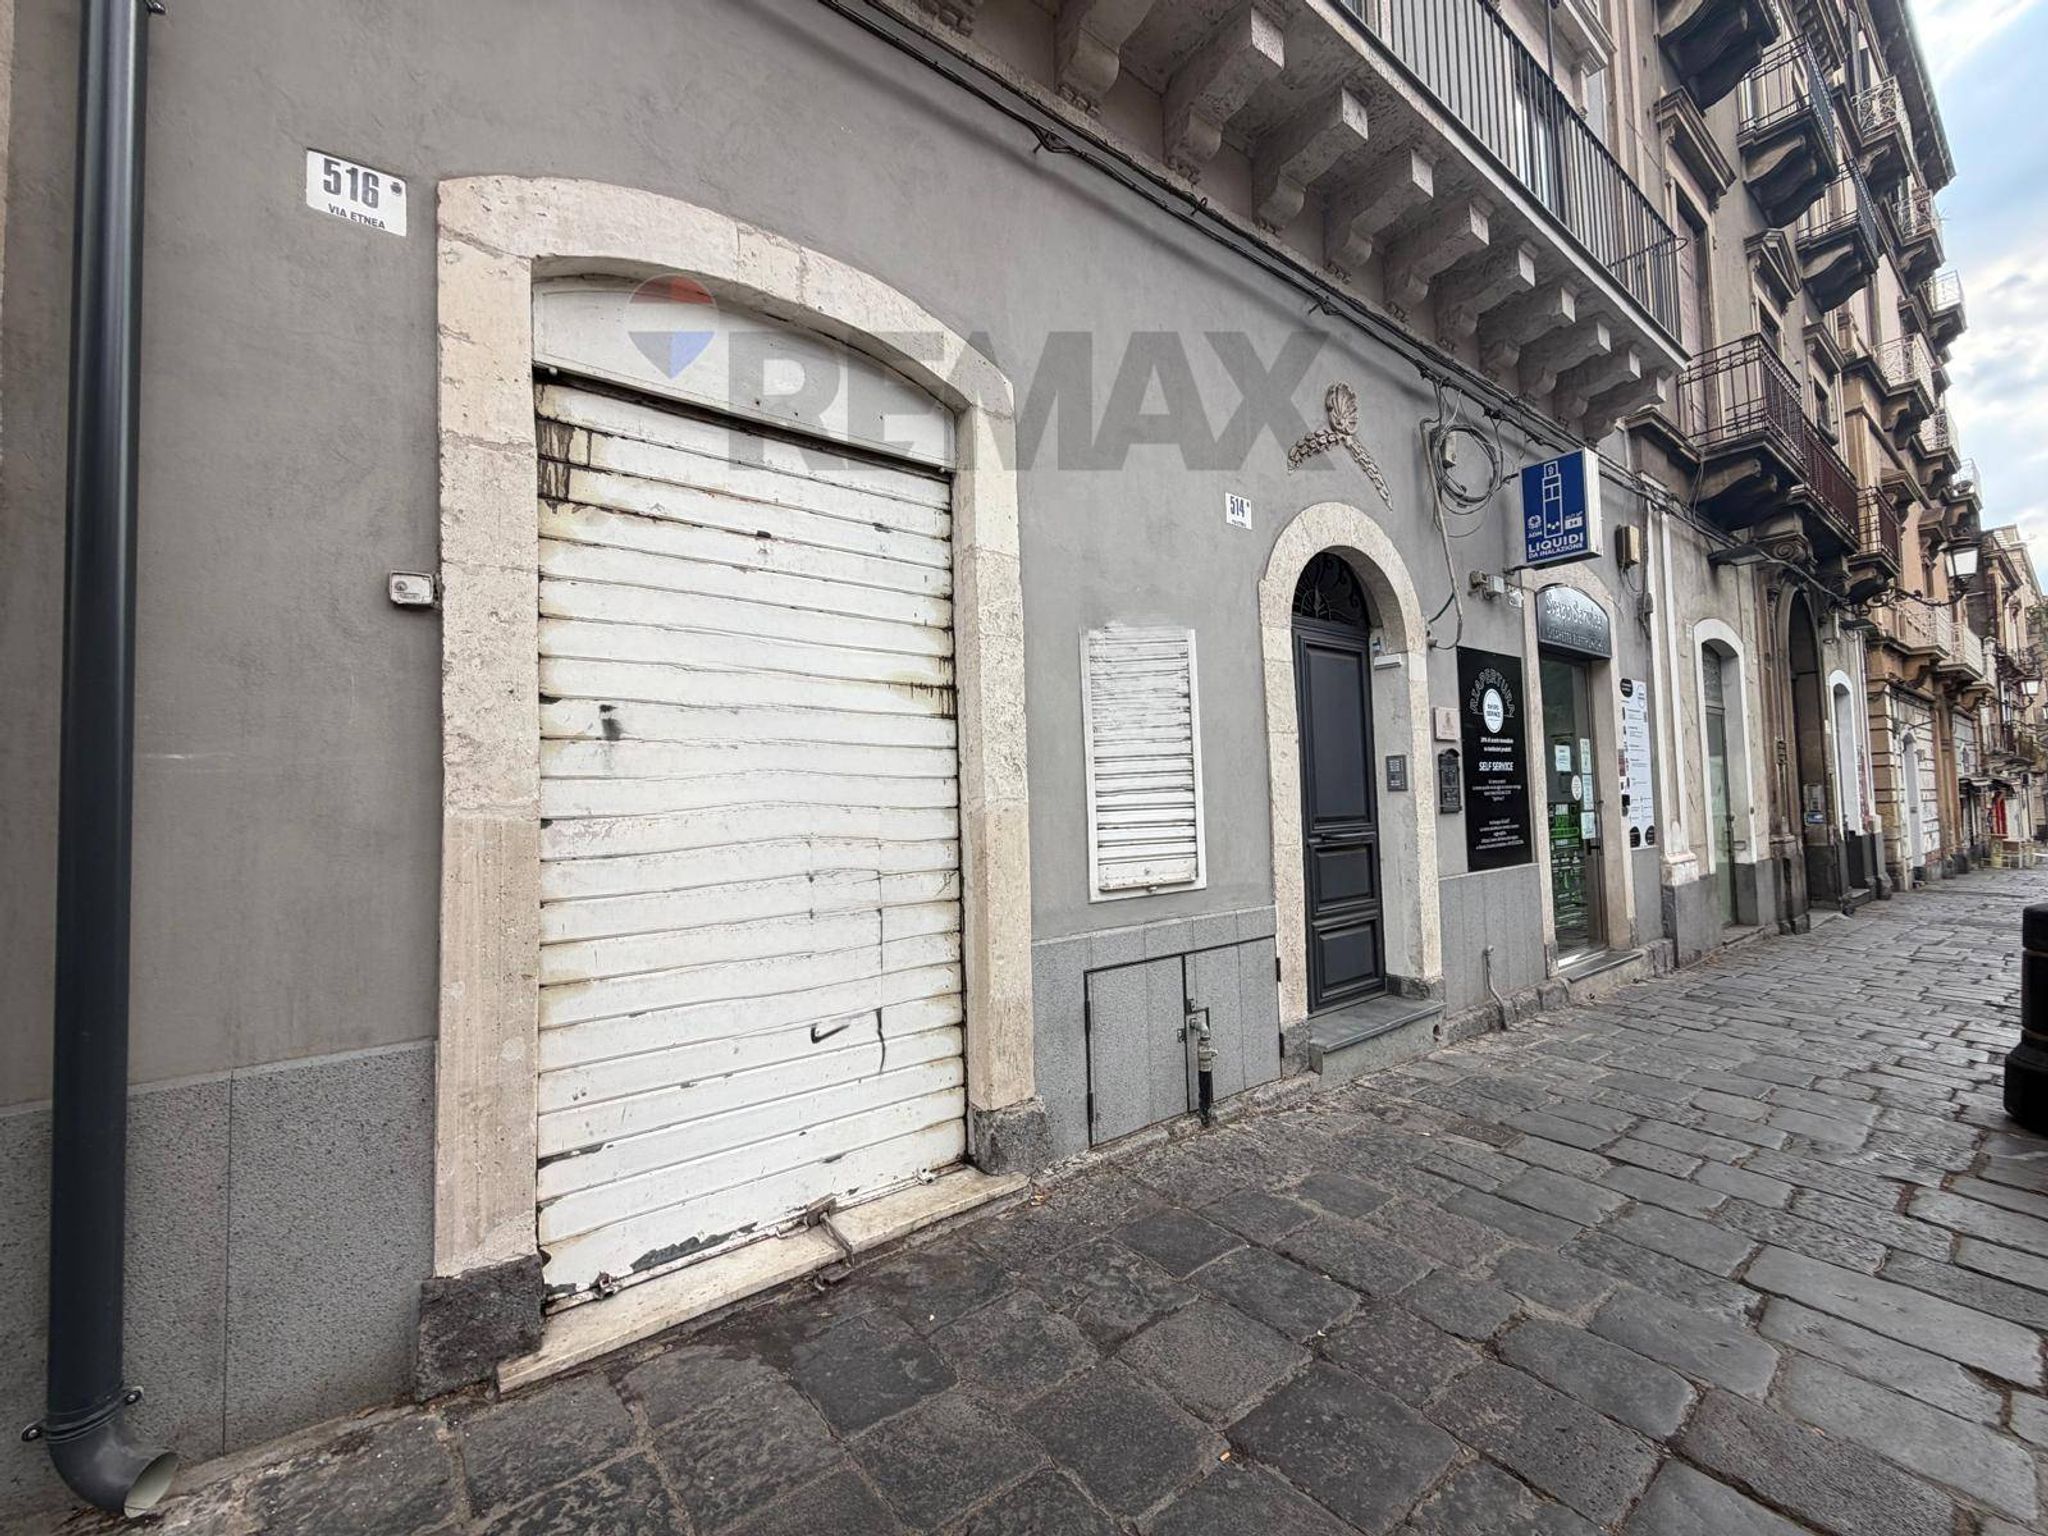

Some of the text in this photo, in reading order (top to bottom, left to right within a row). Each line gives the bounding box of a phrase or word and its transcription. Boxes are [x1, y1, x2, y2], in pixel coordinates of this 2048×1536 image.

[323, 158, 379, 209] 516
[328, 203, 386, 229] VIA ETNEA
[1230, 495, 1245, 518] 514
[1528, 532, 1584, 553] LIQUIDI
[1540, 543, 1583, 556] INALAZIONE
[1479, 761, 1514, 771] SELF SERVICE
